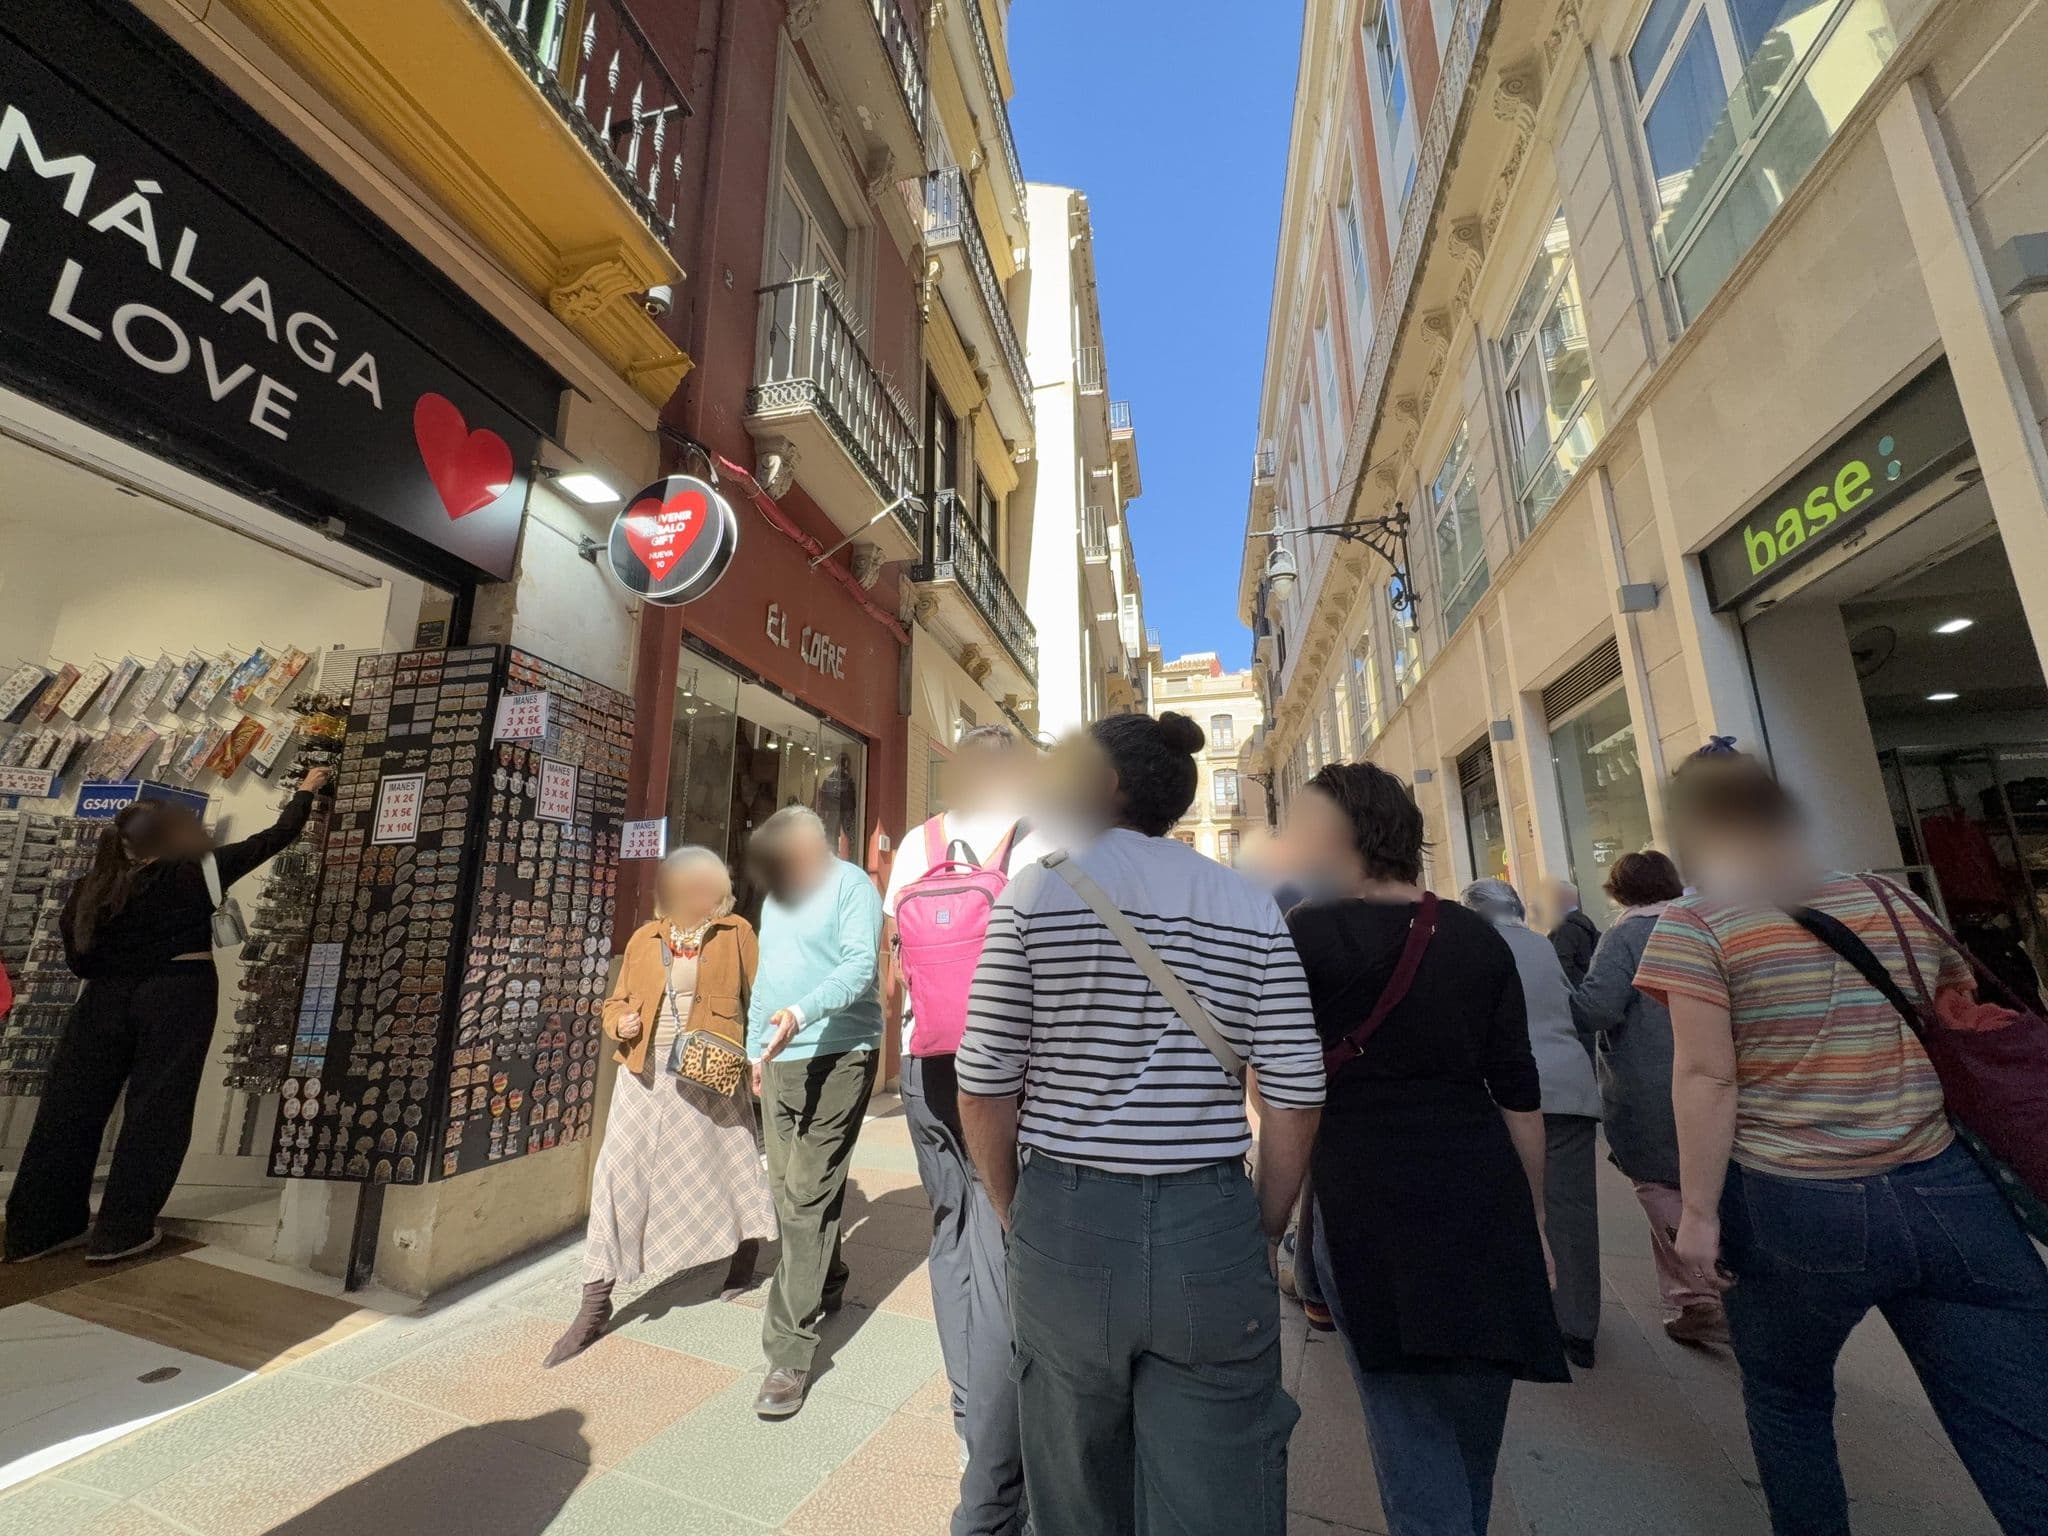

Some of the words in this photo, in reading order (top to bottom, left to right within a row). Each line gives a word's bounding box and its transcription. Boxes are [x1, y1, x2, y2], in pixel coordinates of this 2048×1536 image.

[0, 104, 383, 411] MÁLAGA
[49, 258, 298, 441] LOVE
[651, 534, 675, 546] GIFT
[649, 550, 674, 559] NUEVA
[656, 560, 666, 568] 10
[766, 603, 790, 648] EL
[800, 625, 848, 680] COFRE
[514, 695, 538, 705] IMANES
[528, 705, 540, 713] 2€
[507, 717, 514, 726] 3
[517, 716, 524, 725] X
[527, 715, 541, 724] 5€
[502, 728, 509, 737] 7
[512, 727, 520, 736] X
[524, 726, 543, 736] 10€
[547, 763, 571, 776] IMANES
[22, 782, 46, 790] 12€
[388, 781, 416, 792] IMANES
[546, 775, 550, 783] 1
[553, 776, 558, 785] X
[560, 777, 570, 787] 2€
[386, 795, 391, 804] 1
[394, 795, 400, 803] X
[402, 793, 415, 803] 2€
[544, 787, 549, 796] 3
[551, 788, 557, 798] X
[560, 790, 569, 800] 5€
[383, 809, 389, 818] 3
[391, 808, 398, 817] X
[400, 807, 412, 817] 5€
[541, 801, 546, 809] 7
[548, 802, 554, 811] X
[556, 803, 570, 814] 10€
[379, 824, 385, 833] 7
[386, 823, 393, 832] X
[396, 822, 413, 832] 10€
[633, 821, 656, 830] IMANES
[629, 840, 635, 848] 3
[638, 839, 645, 847] X
[647, 838, 659, 847] 5€
[634, 849, 641, 857] X
